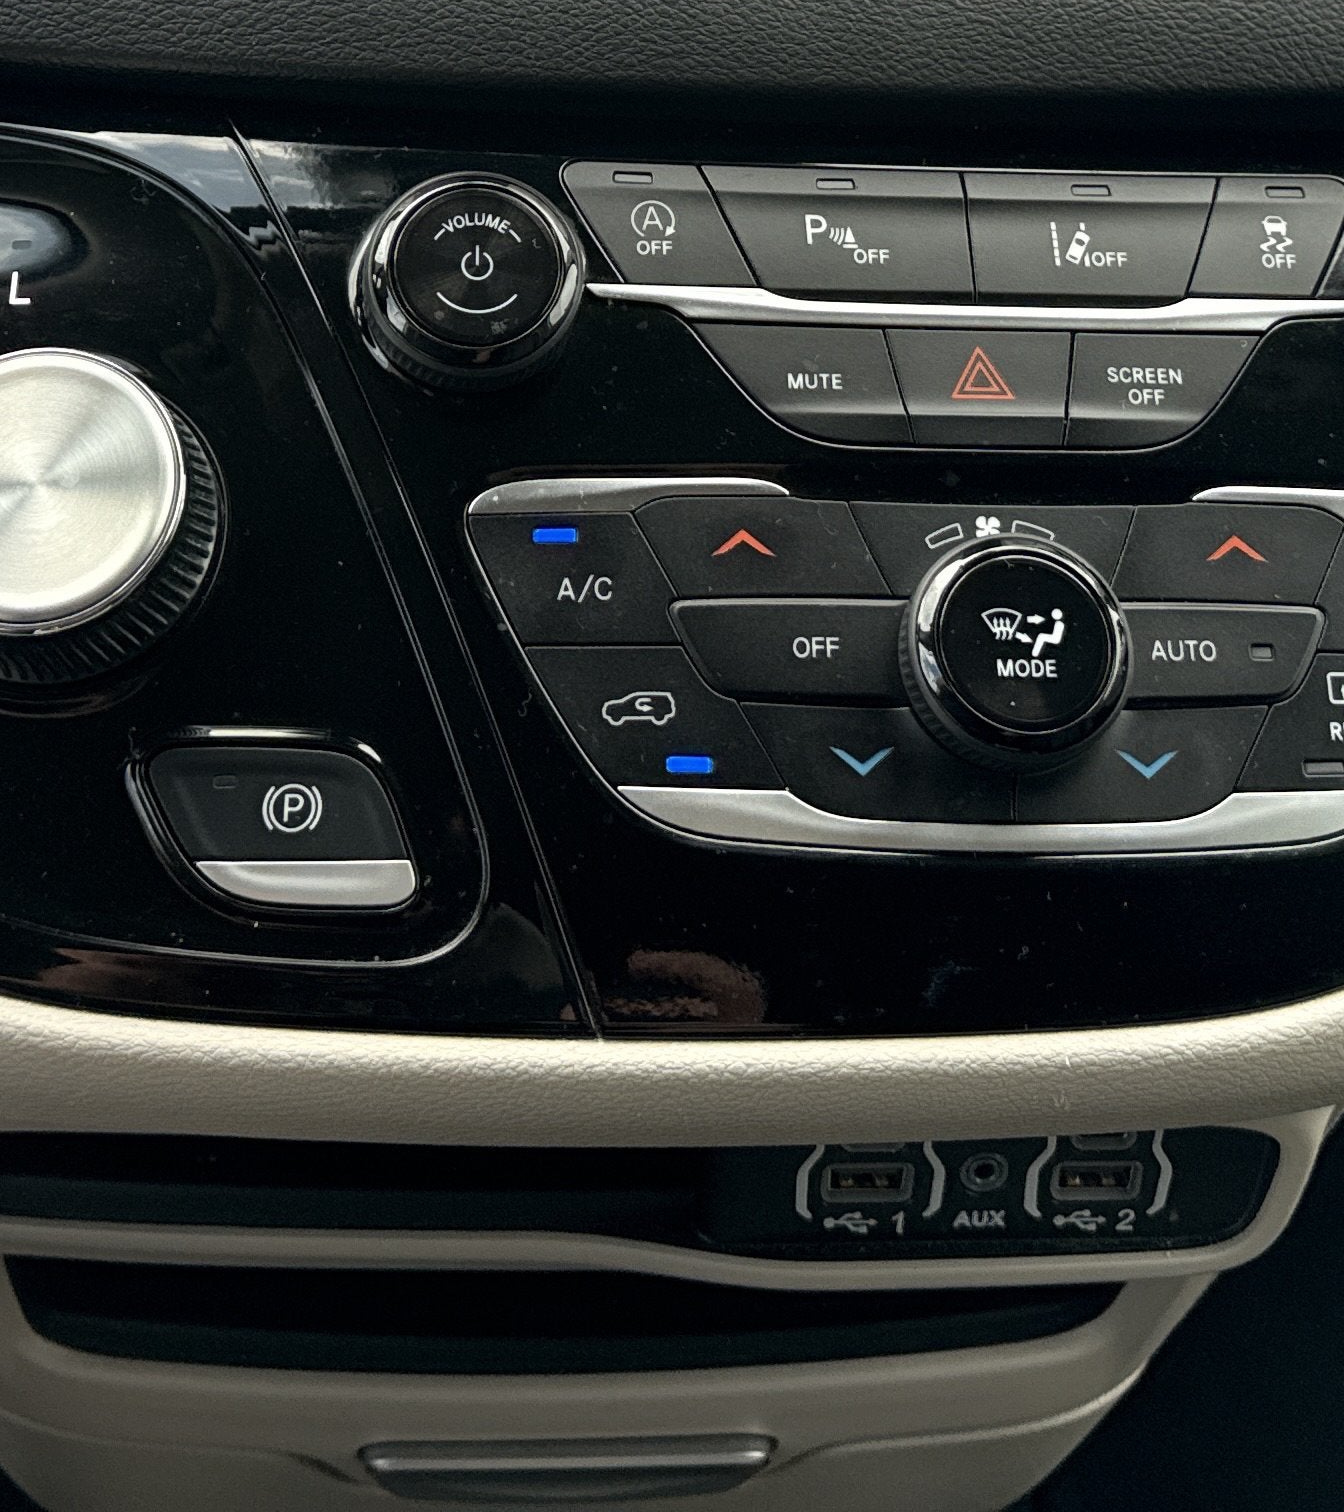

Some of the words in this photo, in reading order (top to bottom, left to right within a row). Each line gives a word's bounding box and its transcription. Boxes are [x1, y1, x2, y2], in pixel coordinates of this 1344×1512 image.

[442, 212, 511, 234] VOLUME
[636, 240, 673, 256] OFF
[853, 248, 890, 265] OFF
[1090, 251, 1128, 267] OFF
[1261, 254, 1297, 269] OFF
[787, 372, 843, 390] MUTE
[1106, 367, 1183, 385] SCREEN
[1127, 389, 1165, 405] OFF
[556, 575, 614, 602] A/C
[791, 636, 840, 660] OFF
[1149, 639, 1218, 663] AUTO
[995, 657, 1058, 679] MODE
[890, 1212, 905, 1235] 1
[953, 1210, 1005, 1229] AUX
[1115, 1209, 1136, 1232] 2
